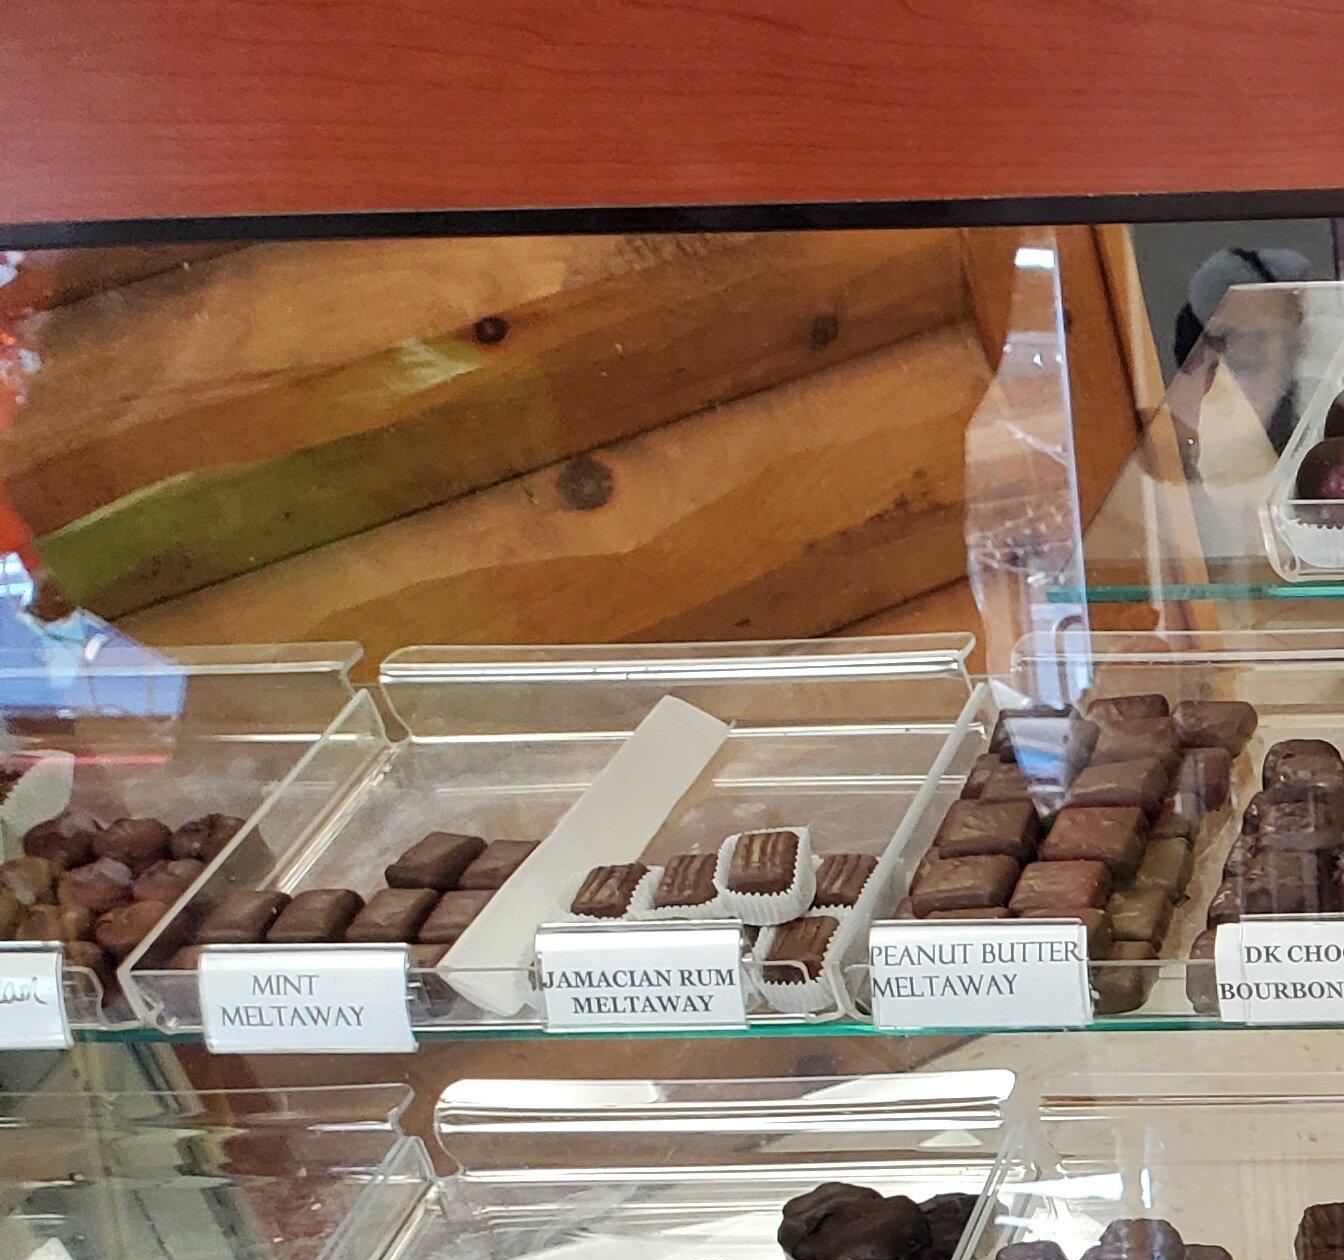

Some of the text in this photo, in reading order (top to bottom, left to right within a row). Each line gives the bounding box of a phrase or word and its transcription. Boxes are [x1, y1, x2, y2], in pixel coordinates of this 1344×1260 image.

[871, 941, 1084, 966] PEANUT BUTTER
[1244, 945, 1283, 964] DK
[252, 975, 319, 996] MINT
[542, 967, 736, 989] JAMACIAN RUM
[872, 974, 1018, 998] MELTAWAY
[1220, 980, 1343, 1000] BOURBON
[572, 995, 714, 1014] MELTAWAY
[221, 1006, 364, 1027] MELTAWAY
